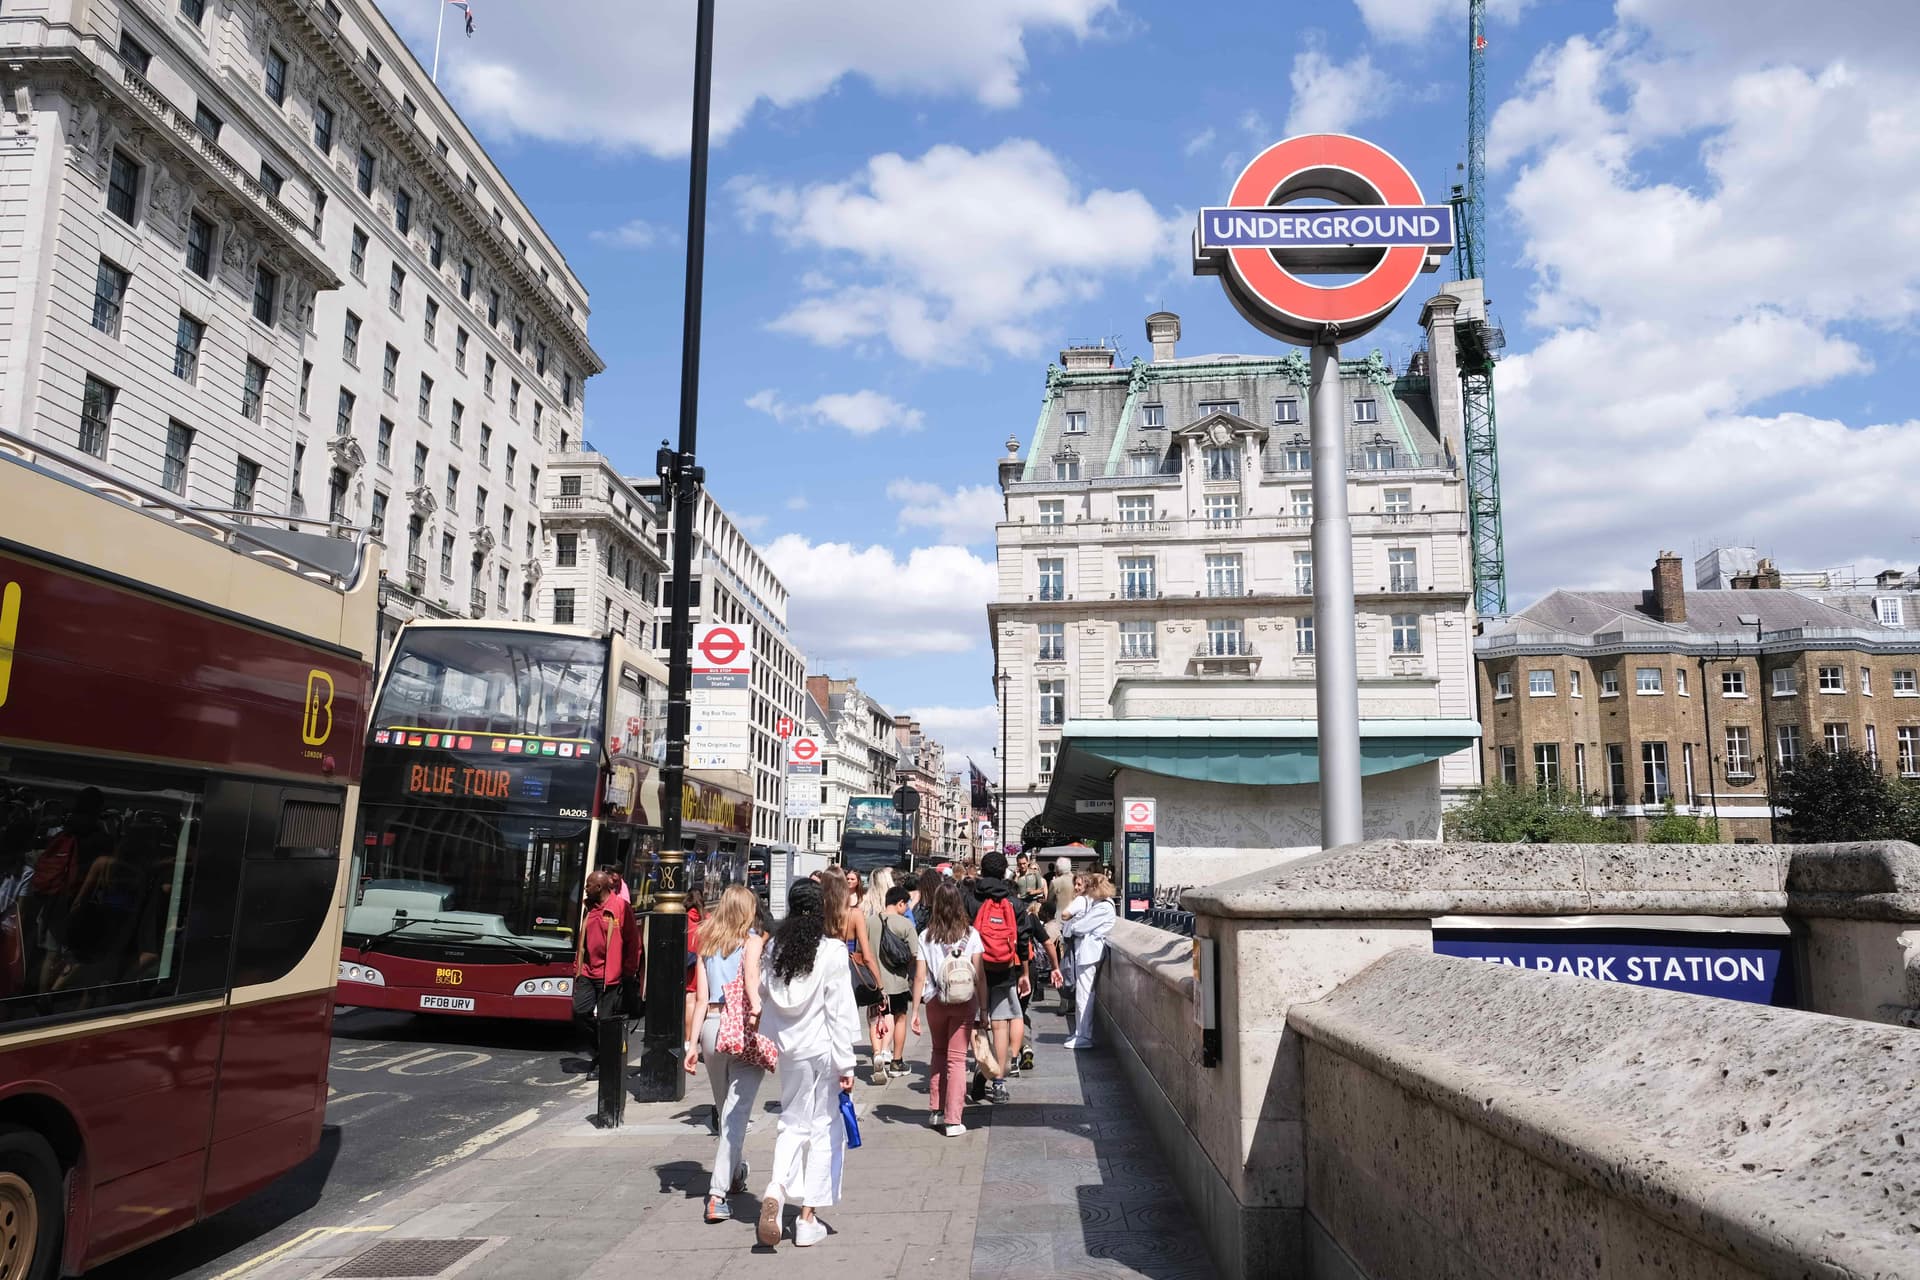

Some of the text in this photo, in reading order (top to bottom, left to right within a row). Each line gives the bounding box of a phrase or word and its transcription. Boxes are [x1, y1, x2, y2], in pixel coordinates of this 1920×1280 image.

[1213, 215, 1440, 239] UNDERGROUND
[304, 750, 323, 759] LONDON
[410, 764, 456, 794] BLUE
[463, 768, 511, 798] TOUR
[559, 808, 588, 818] DA205
[436, 968, 451, 977] BIG
[1536, 956, 1619, 981] PARK
[1626, 956, 1766, 982] STATION
[435, 976, 451, 985] BUS
[451, 999, 471, 1009] URV
